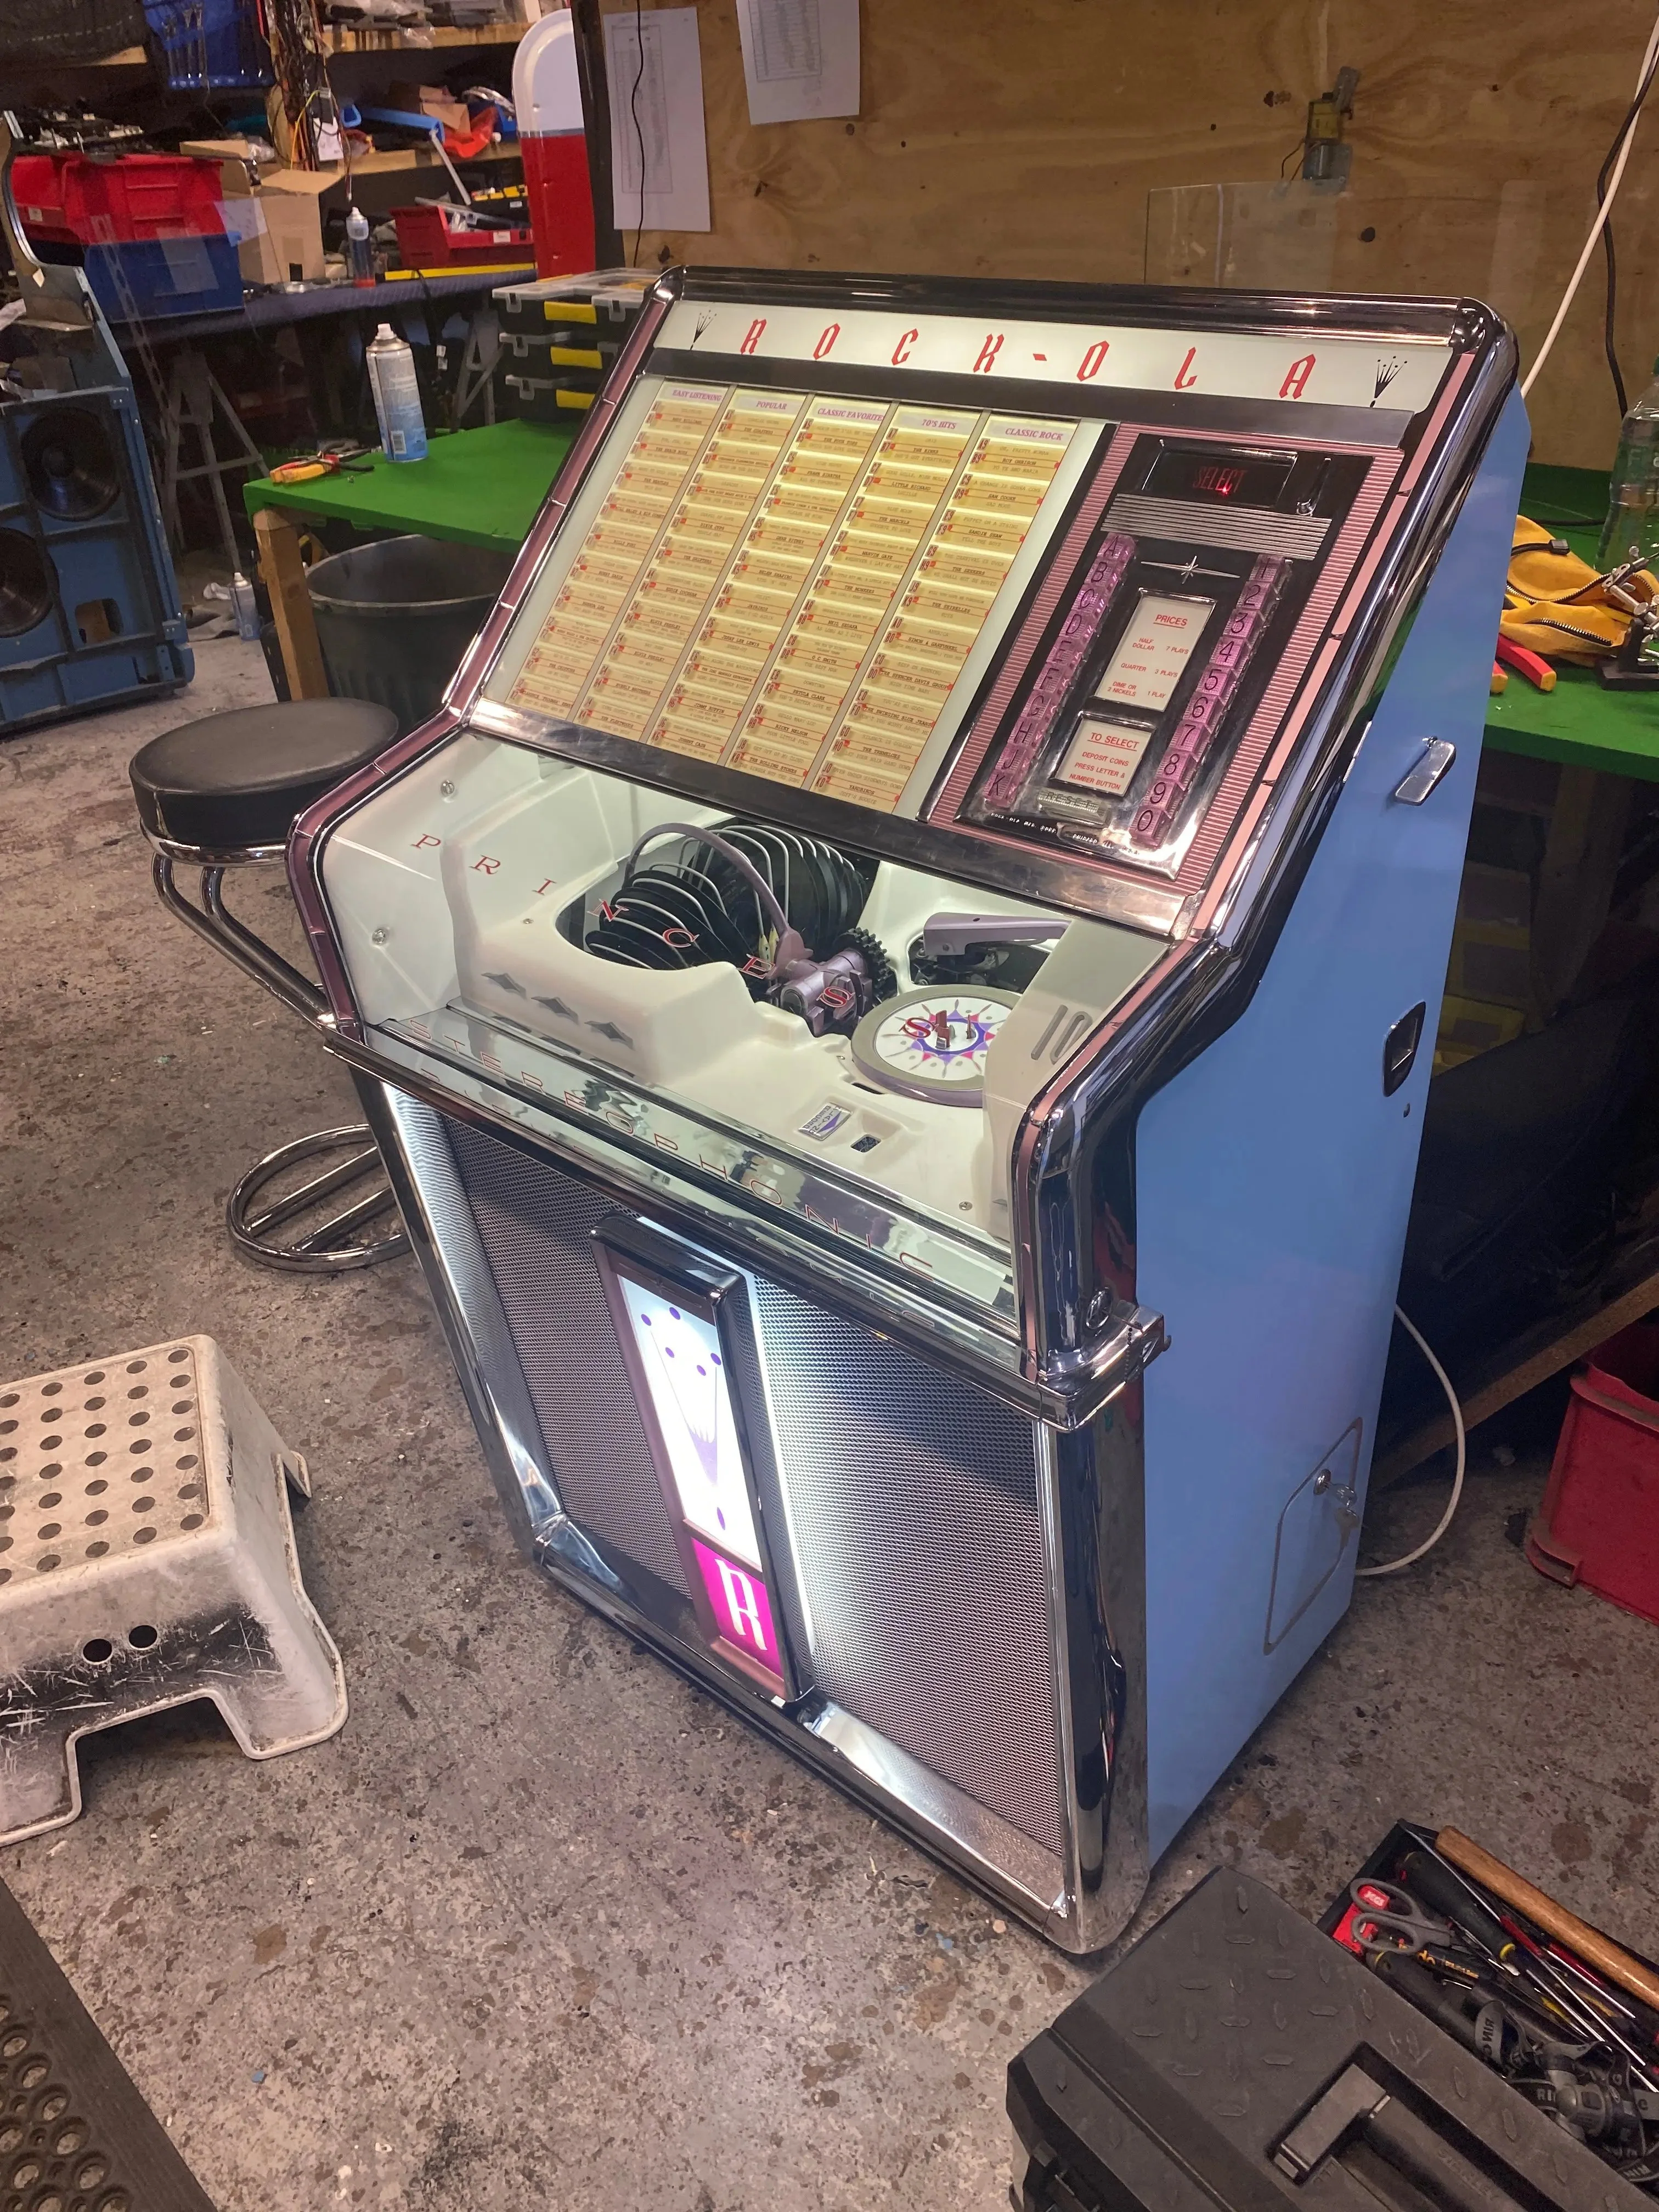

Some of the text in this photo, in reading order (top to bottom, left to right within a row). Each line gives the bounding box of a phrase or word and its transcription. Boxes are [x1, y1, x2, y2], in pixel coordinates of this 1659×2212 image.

[672, 390, 722, 401] EASY LISTENING
[755, 400, 788, 410] POPULAR
[816, 408, 847, 417] CLASSIC
[938, 421, 957, 429] HITS
[1005, 427, 1064, 441] CLASSIC ROCK
[978, 439, 989, 449] A9
[970, 453, 982, 463] B9
[961, 475, 972, 485] C9
[1193, 466, 1246, 493] SELECT
[926, 546, 938, 556] G9
[1104, 537, 1118, 557] A
[919, 560, 930, 571] H9
[1091, 561, 1107, 582] B
[1261, 557, 1271, 578] 1
[909, 582, 919, 592] J9
[1080, 589, 1097, 610] C
[1248, 584, 1261, 606] 2
[902, 596, 913, 607] K9
[943, 604, 970, 613] SHIRELLES
[891, 618, 902, 628] A0
[1066, 614, 1081, 635] D
[1155, 614, 1187, 626] PRICES
[1231, 612, 1247, 634] 3
[884, 632, 895, 643] B0
[930, 642, 958, 651] GARFUNKEL
[1056, 640, 1072, 662] E
[1132, 642, 1154, 651] DOLLAR
[1219, 641, 1233, 662] 4
[874, 654, 885, 665] C0
[1121, 663, 1147, 672] QUARTER
[891, 673, 913, 681] SPENCER
[1040, 668, 1059, 689] F
[1204, 669, 1219, 690] 5
[1113, 688, 1136, 697] NICKELS
[1030, 695, 1044, 716] G
[1192, 697, 1208, 718] 6
[876, 709, 900, 719] SWINGING
[791, 728, 808, 736] NELSON
[839, 726, 850, 737] G0
[1015, 721, 1032, 743] H
[1183, 724, 1197, 746] 7
[832, 740, 843, 752] H0
[1091, 732, 1139, 749] TO SELECT
[873, 749, 900, 760] TREMELOES
[1003, 749, 1018, 769] J
[1082, 752, 1129, 766] DEPOSIT COINS
[759, 760, 778, 769] ROLLING
[822, 762, 833, 773] J0
[1075, 763, 1094, 771] PRESS
[1096, 767, 1119, 776] LETTER
[1164, 753, 1180, 776] 8
[815, 776, 826, 787] K0
[989, 774, 1006, 795] K
[1069, 774, 1121, 790] NUMBER BUTTON
[848, 784, 875, 795] YARDBIRDS
[1150, 782, 1167, 804] 9
[1046, 792, 1092, 808] RESET
[1137, 810, 1153, 832] 0
[410, 1019, 933, 1283] STEREOPHONIC
[714, 1558, 768, 1651] R
